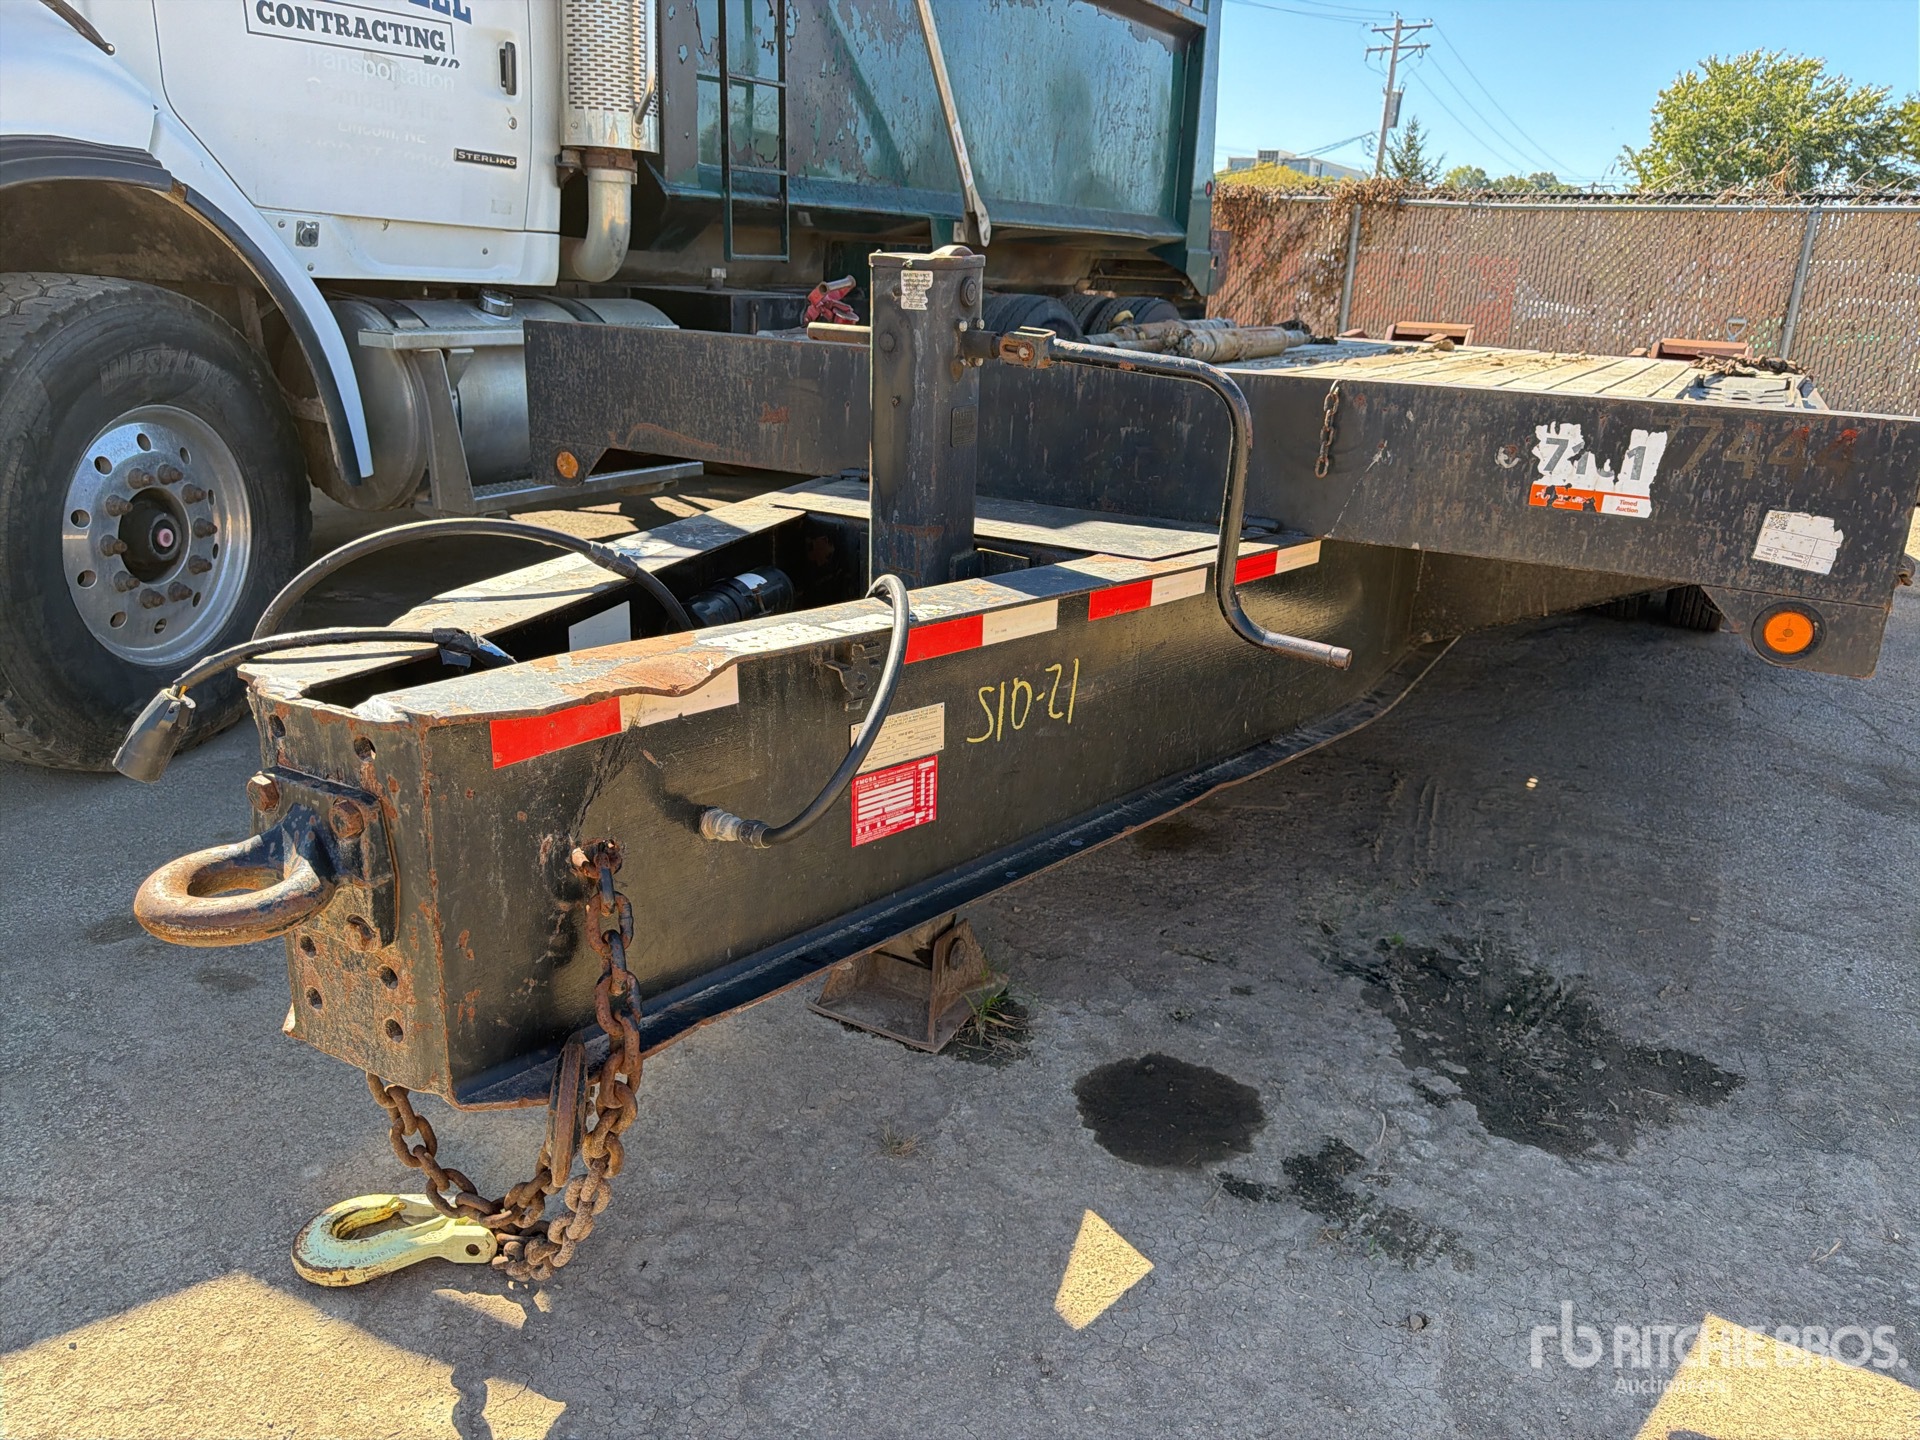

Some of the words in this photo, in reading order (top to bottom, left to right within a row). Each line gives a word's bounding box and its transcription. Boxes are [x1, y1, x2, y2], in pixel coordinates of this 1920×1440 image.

[256, 1, 446, 51] CONTRACTING
[458, 151, 516, 166] STERLING
[1543, 437, 1647, 481] 711
[1615, 505, 1639, 514] Auction
[1619, 499, 1638, 507] Timed
[966, 658, 1080, 743] S10-21
[855, 775, 877, 786] FMCSA
